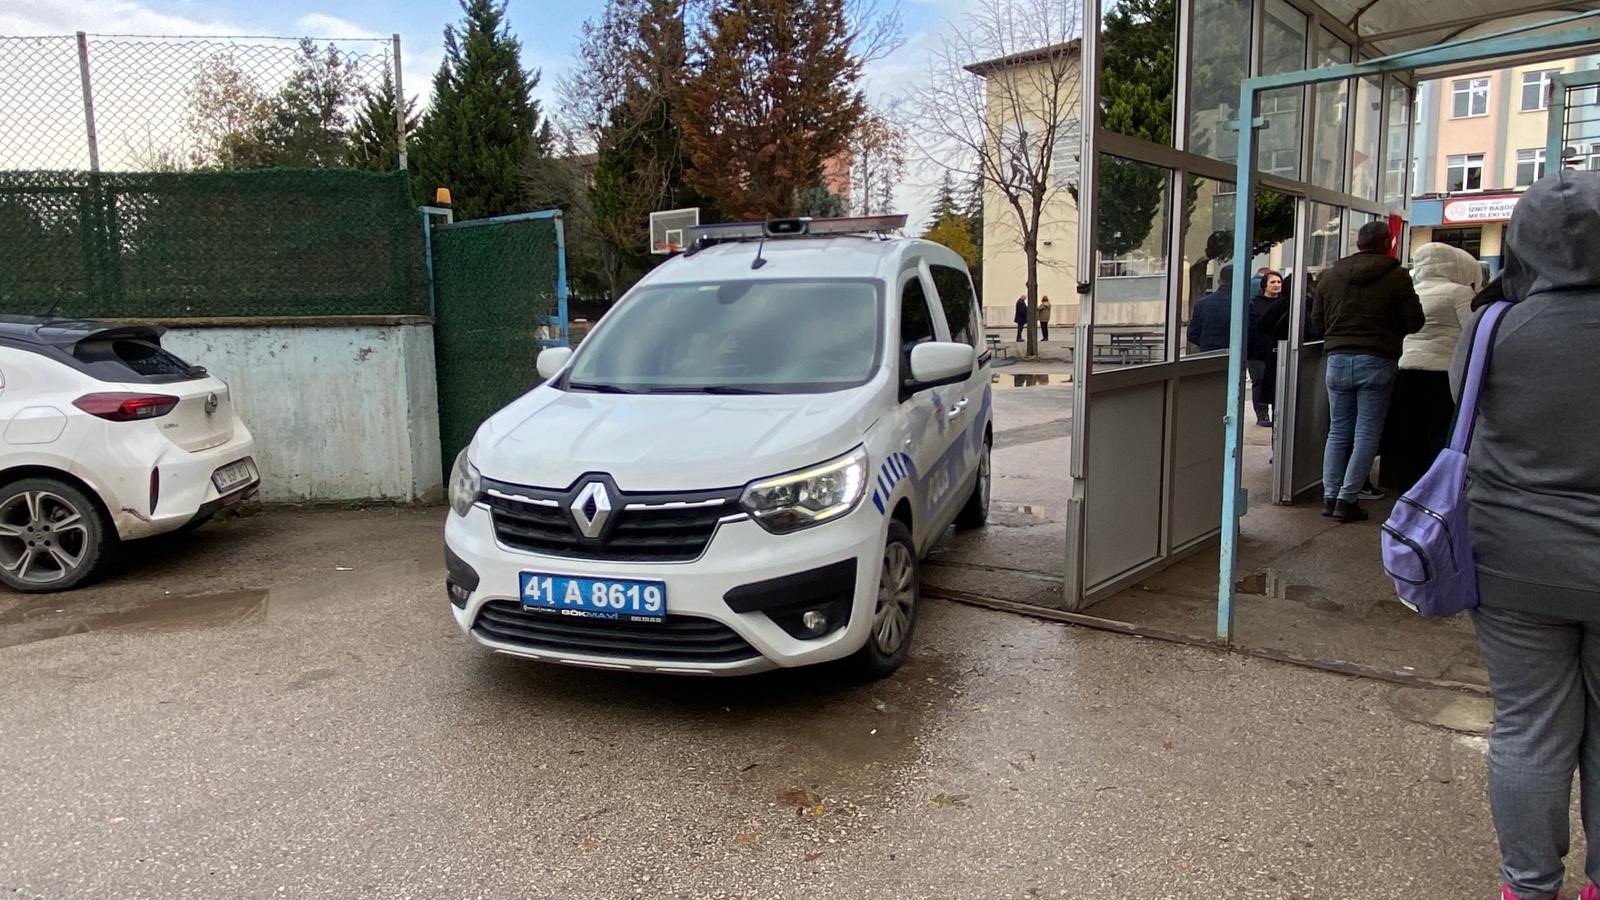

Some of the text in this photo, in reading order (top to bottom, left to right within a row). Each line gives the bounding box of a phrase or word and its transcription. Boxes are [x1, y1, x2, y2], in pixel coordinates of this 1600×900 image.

[525, 576, 661, 612] 41 A 8619
